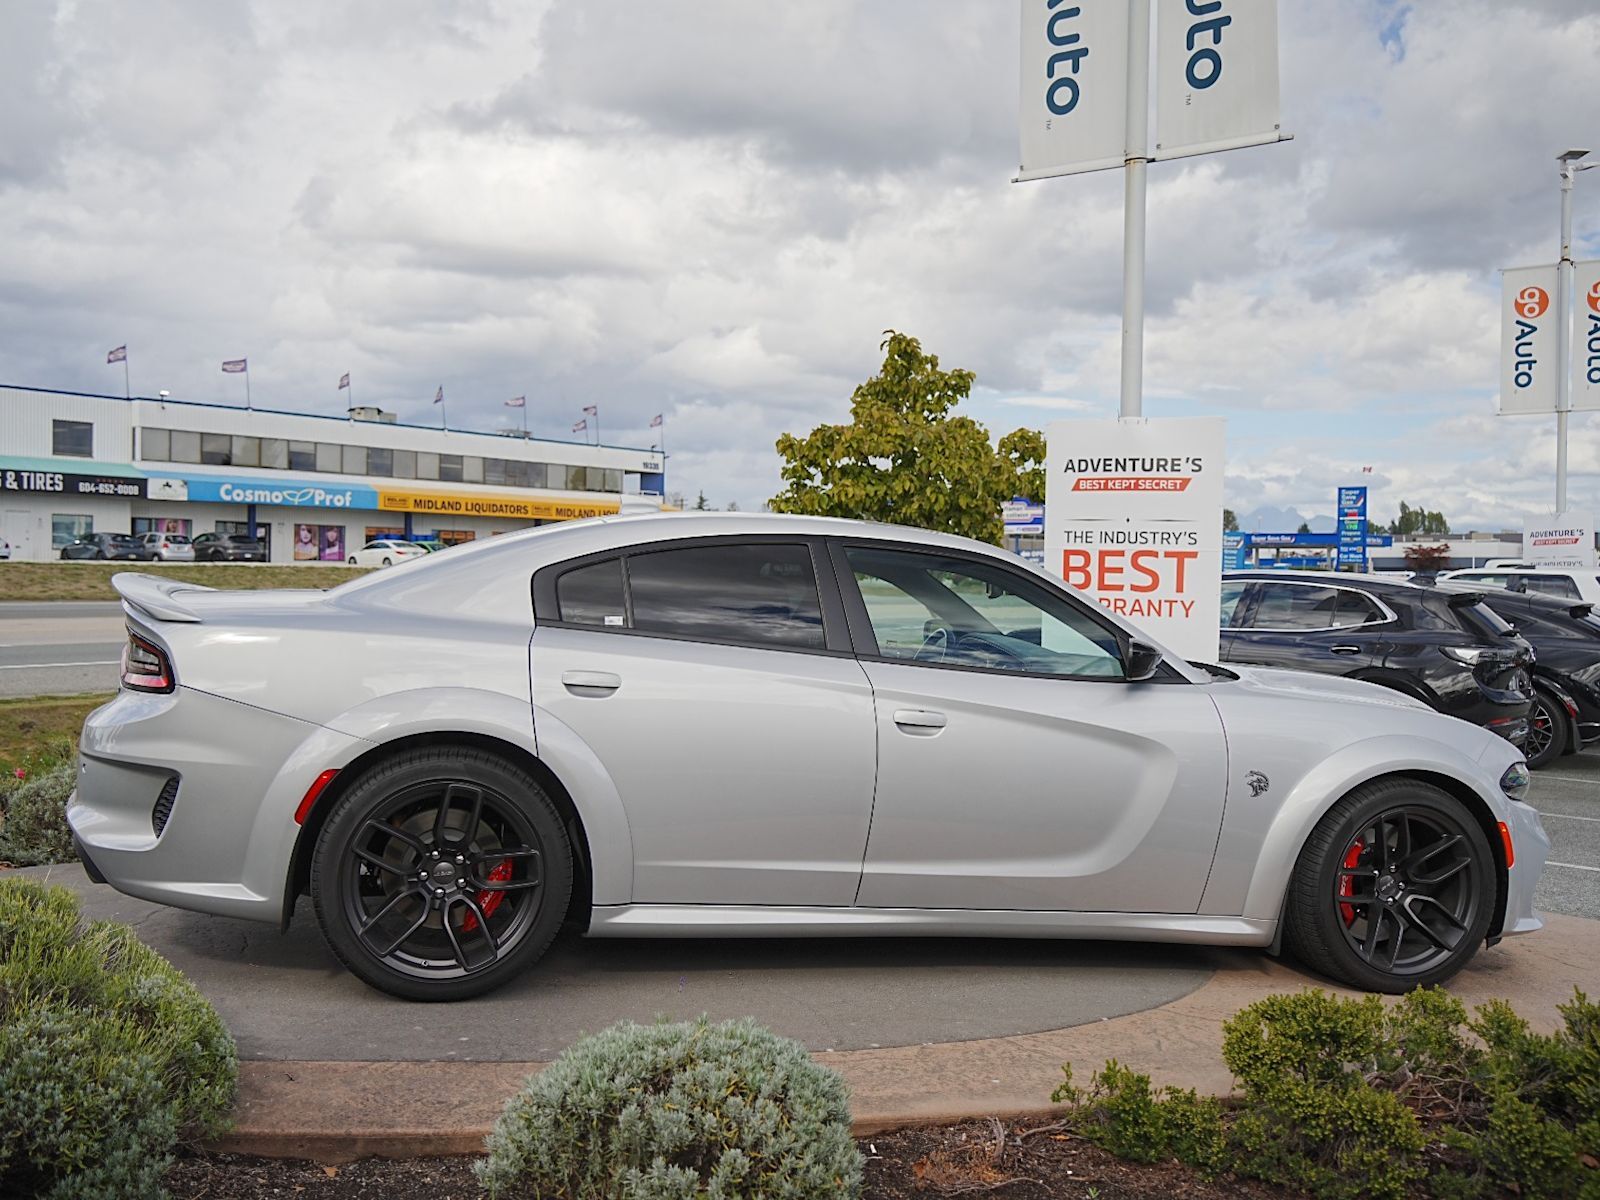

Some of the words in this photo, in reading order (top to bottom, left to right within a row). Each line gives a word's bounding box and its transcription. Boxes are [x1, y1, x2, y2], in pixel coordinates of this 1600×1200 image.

[1185, 0, 1232, 90] uto
[1515, 320, 1537, 388] Auto
[1063, 457, 1203, 473] ADVENTURE'S
[6, 471, 19, 490] &
[20, 472, 64, 492] TIRES
[1079, 479, 1106, 490] BEST
[1107, 479, 1136, 490] KEPT
[1138, 479, 1183, 490] SECRET
[219, 483, 284, 504] Cosmo
[313, 489, 353, 507] Prof
[413, 498, 462, 511] MIDLAND
[465, 501, 529, 515] LIQUIDATORS
[555, 507, 596, 519] MIDLAND
[1063, 530, 1094, 544] THE
[1099, 531, 1198, 546] INDUSTRY'S
[1530, 529, 1584, 538] ADVENTURE'S
[1063, 549, 1199, 593] BEST
